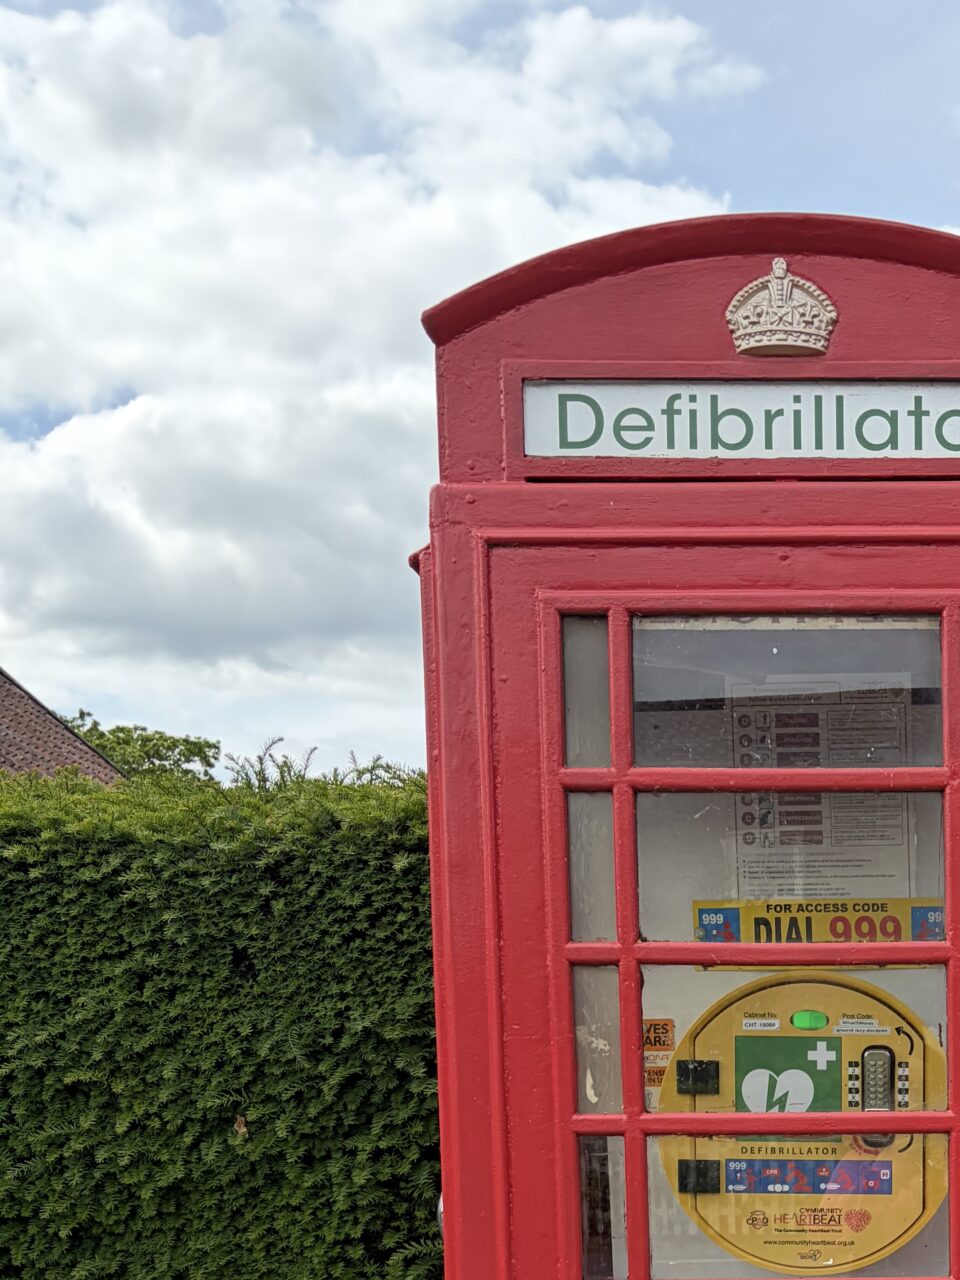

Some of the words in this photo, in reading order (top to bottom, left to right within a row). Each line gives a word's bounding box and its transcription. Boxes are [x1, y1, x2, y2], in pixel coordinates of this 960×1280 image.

[766, 904, 792, 913] FOR
[797, 903, 848, 913] ACCESS
[853, 903, 888, 913] CODE
[702, 914, 723, 924] 999
[928, 912, 945, 922] 99
[754, 916, 812, 943] DIAL
[830, 916, 902, 942] 999
[741, 1146, 837, 1155] DEFIBRILLATOR
[729, 1162, 747, 1170] 999
